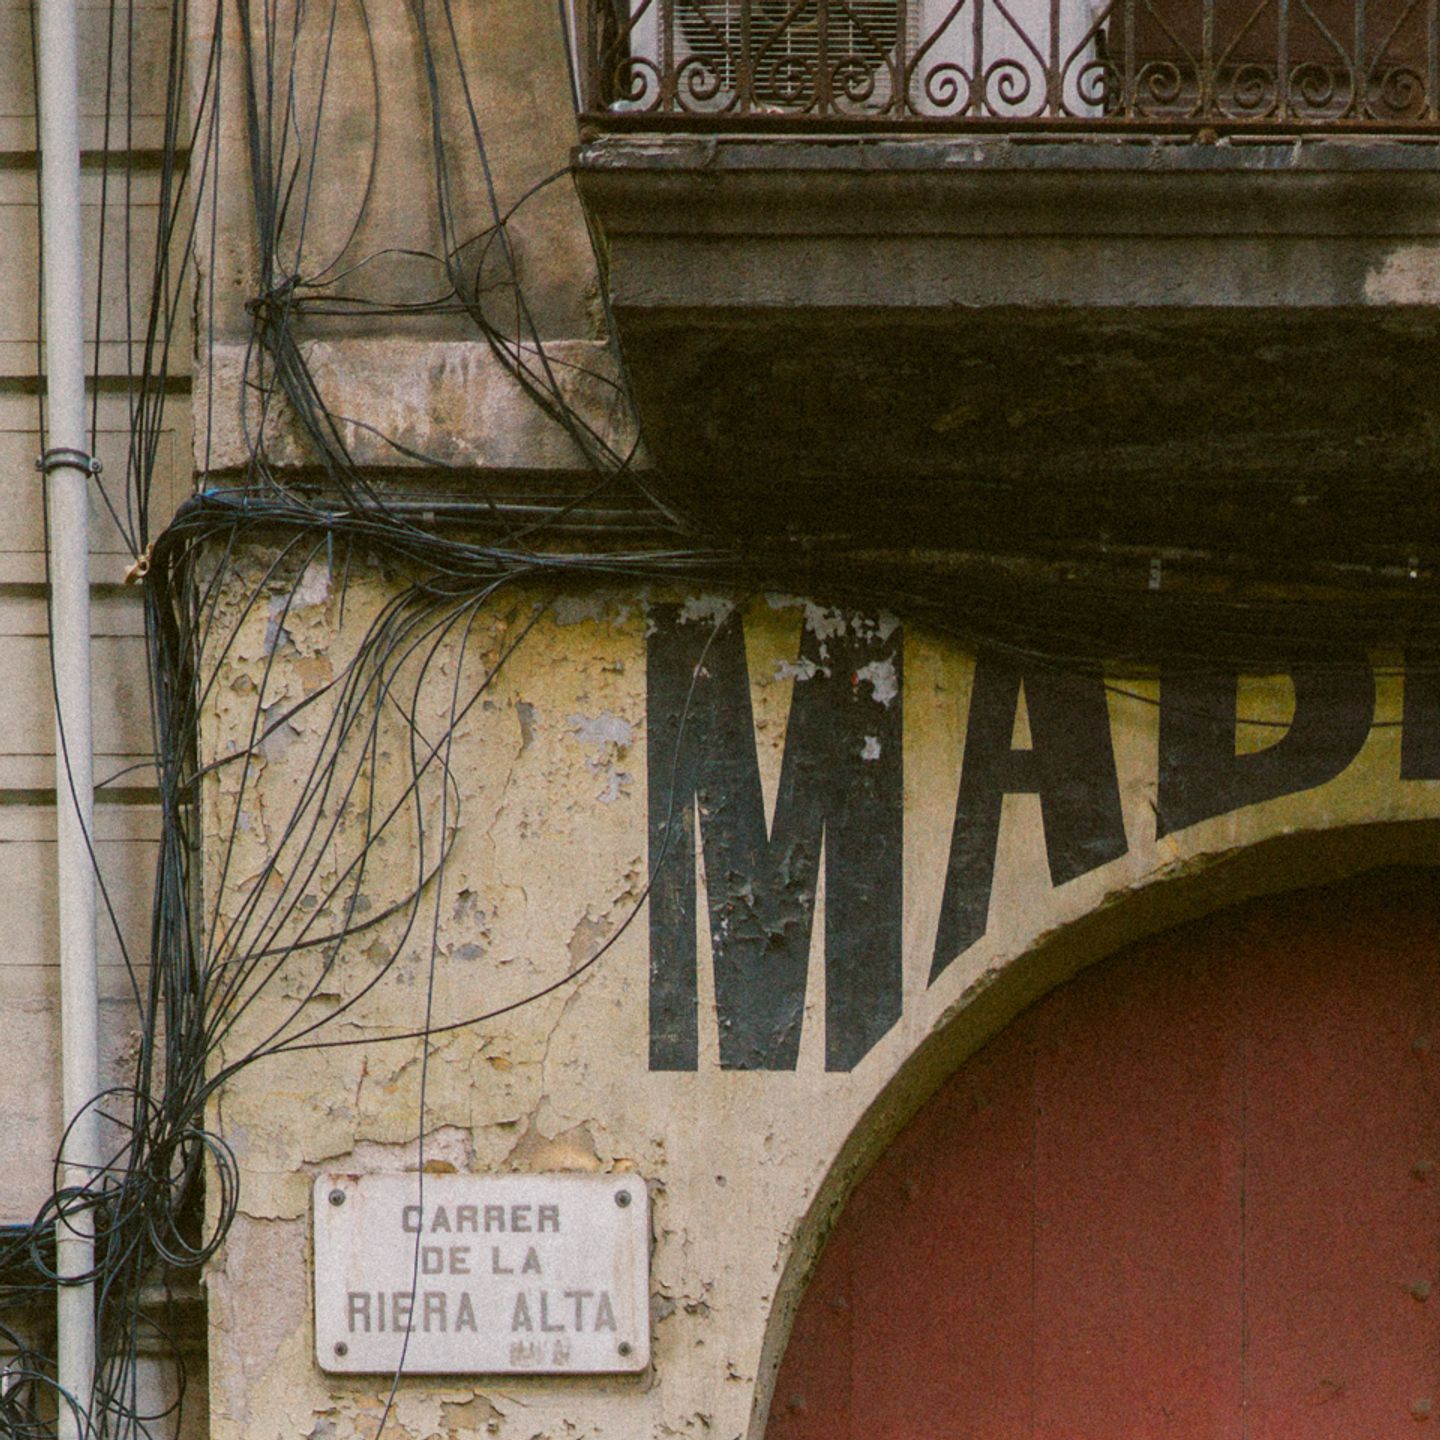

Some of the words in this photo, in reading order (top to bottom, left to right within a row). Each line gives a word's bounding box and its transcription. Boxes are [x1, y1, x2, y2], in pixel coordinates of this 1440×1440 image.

[401, 1204, 561, 1234] CARRER
[421, 1246, 472, 1275] DE
[492, 1246, 542, 1275] LA
[346, 1291, 478, 1333] RIERA
[511, 1291, 618, 1333] ALTA
